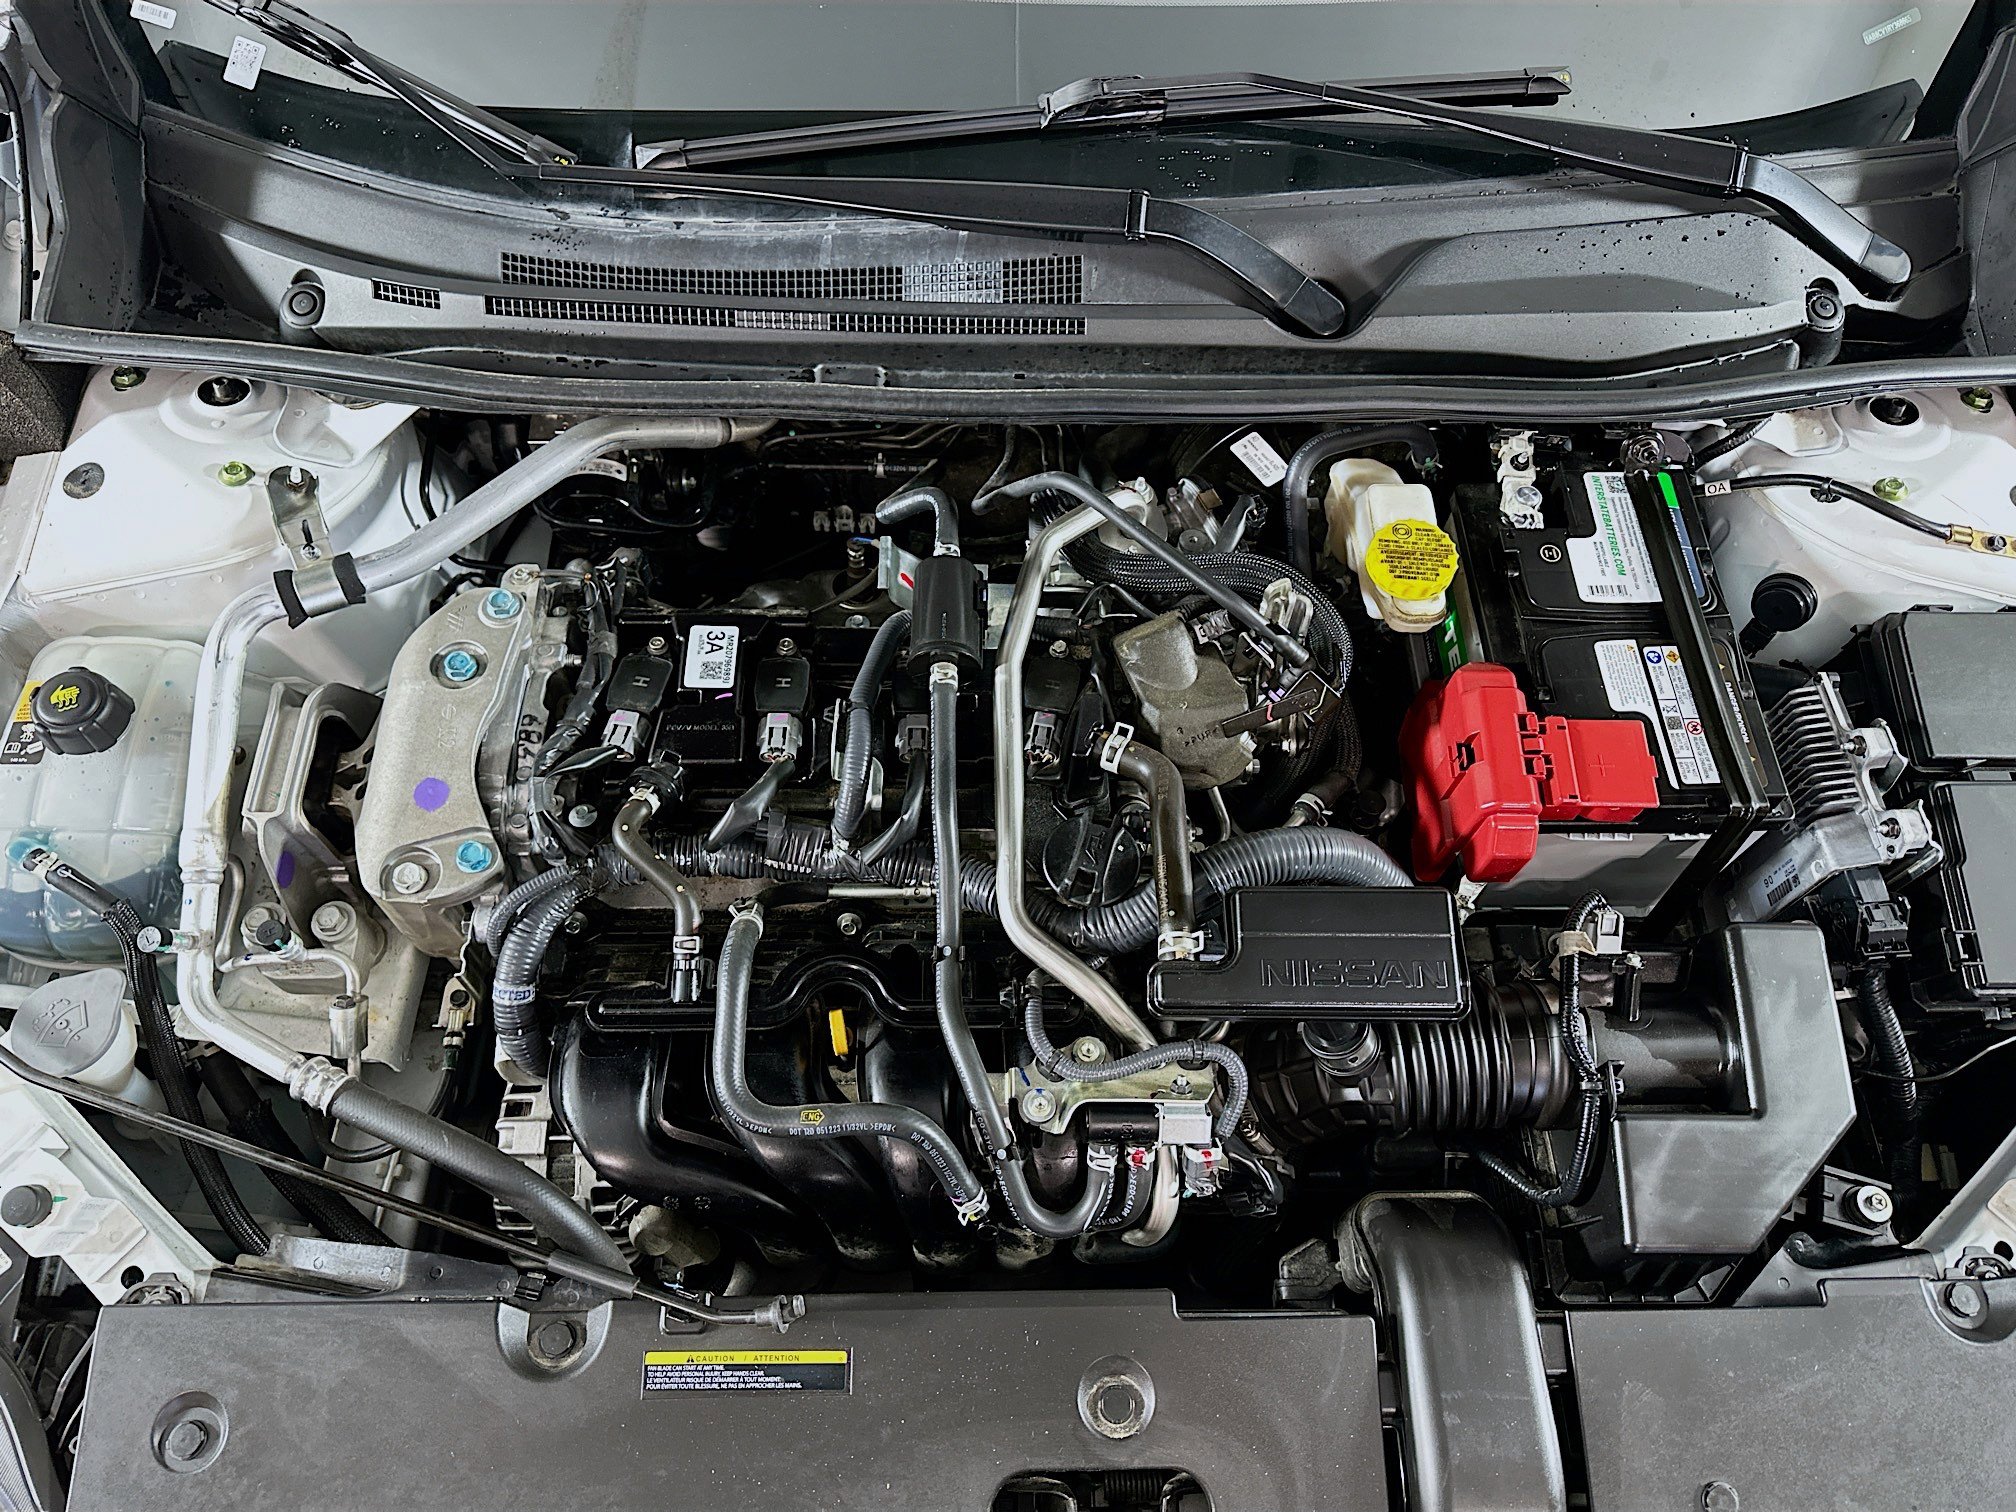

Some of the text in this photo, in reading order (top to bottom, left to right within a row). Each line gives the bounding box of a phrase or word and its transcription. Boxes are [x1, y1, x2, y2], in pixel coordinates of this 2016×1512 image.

[1591, 475, 1627, 577] INTERSTATEBATTERIES.COM
[704, 630, 725, 655] 3A
[1725, 682, 1749, 743] DANGER/POISON
[1261, 958, 1449, 989] NISSAN
[816, 1124, 841, 1135] 051223
